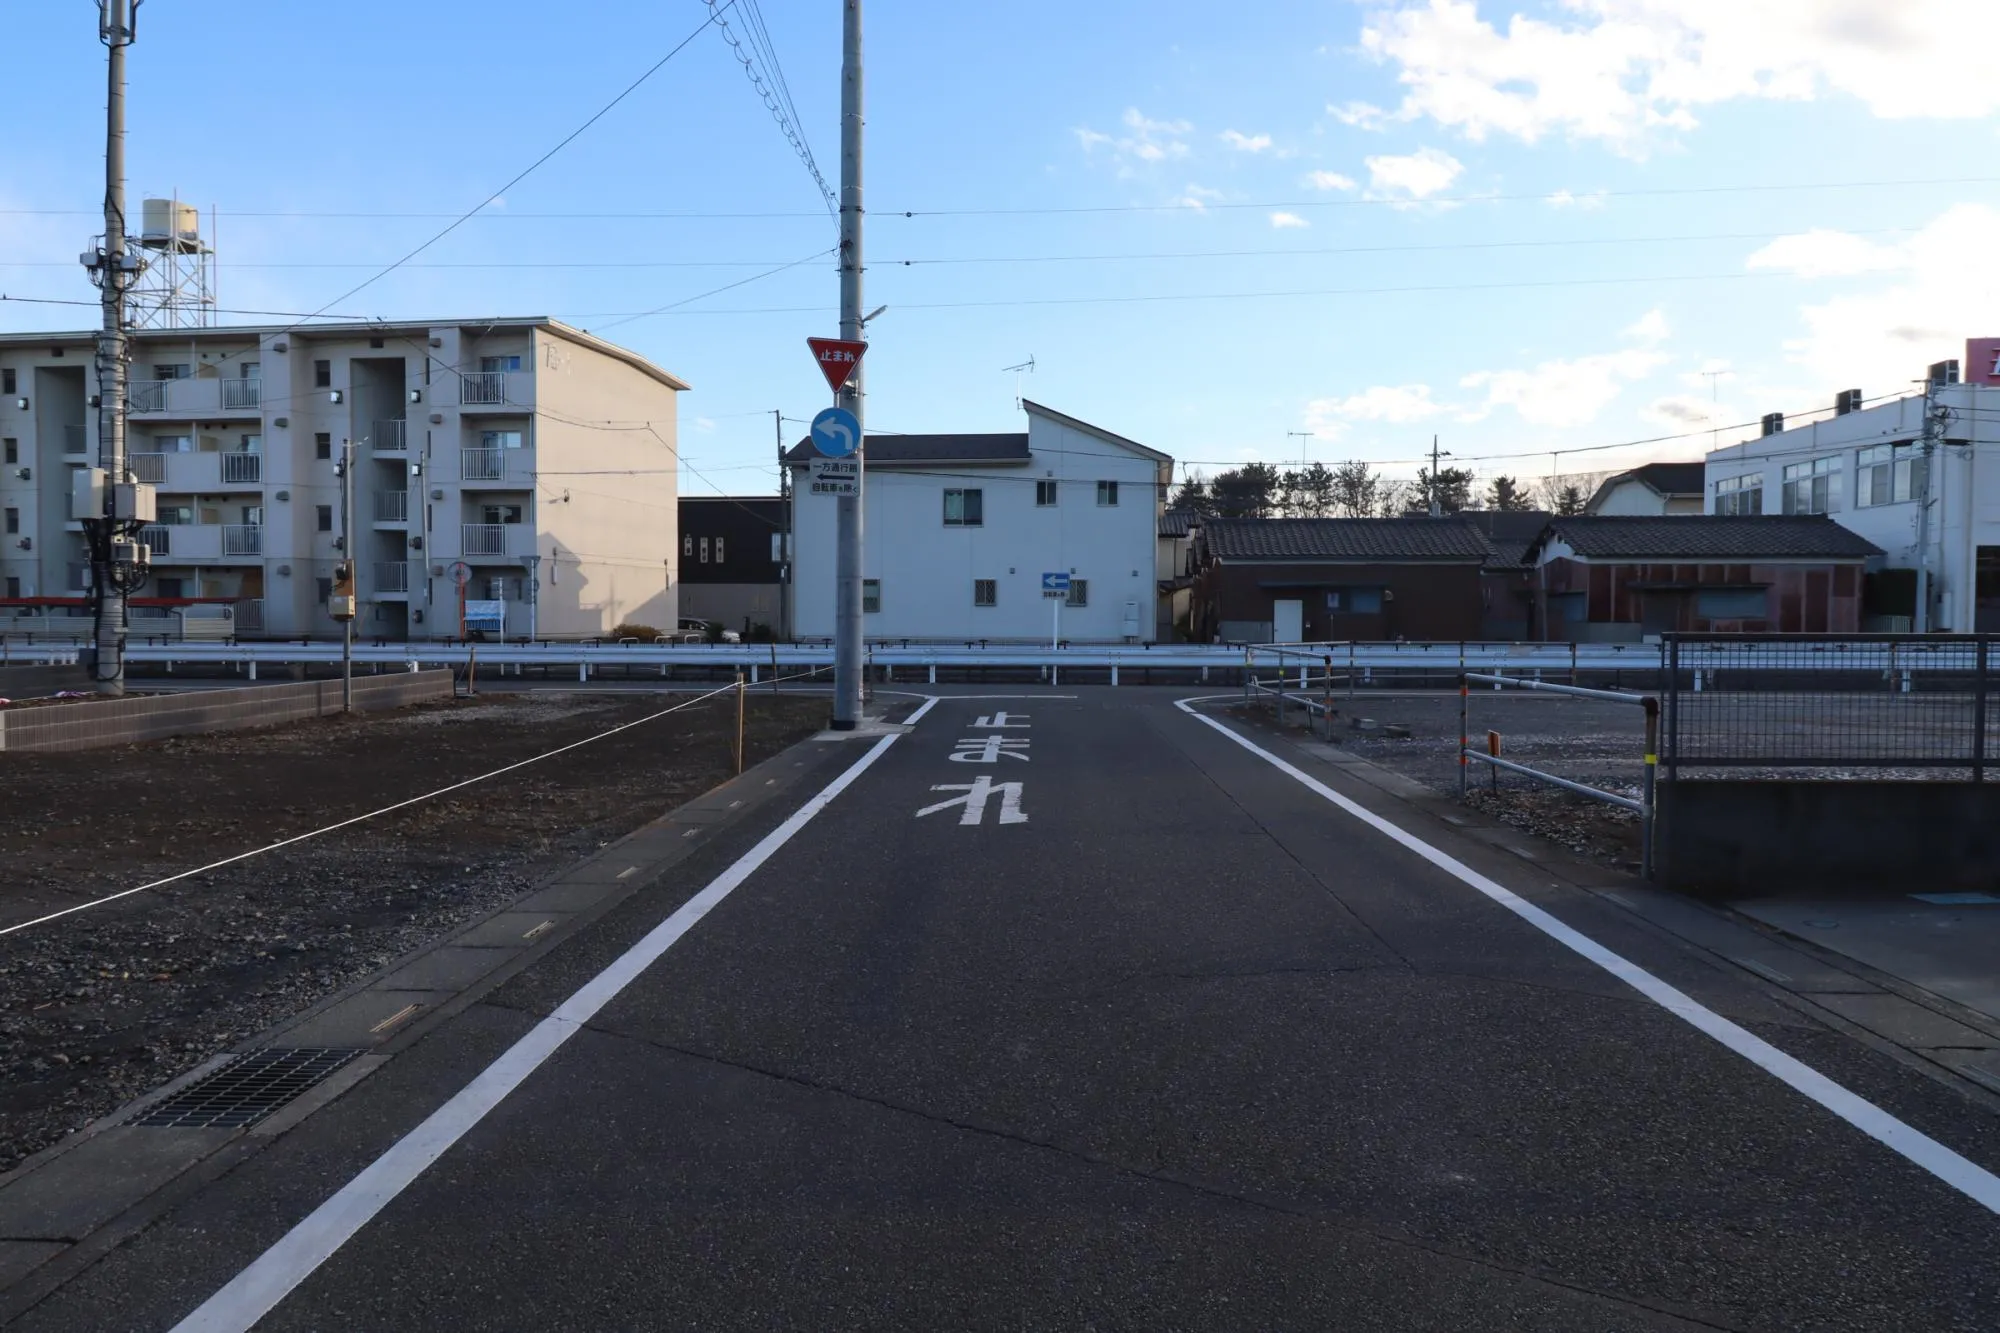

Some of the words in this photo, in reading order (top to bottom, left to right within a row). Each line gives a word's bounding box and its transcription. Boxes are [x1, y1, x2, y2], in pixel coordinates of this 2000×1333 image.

[821, 349, 855, 362] 止まれ
[915, 711, 1031, 825] 止まれ
